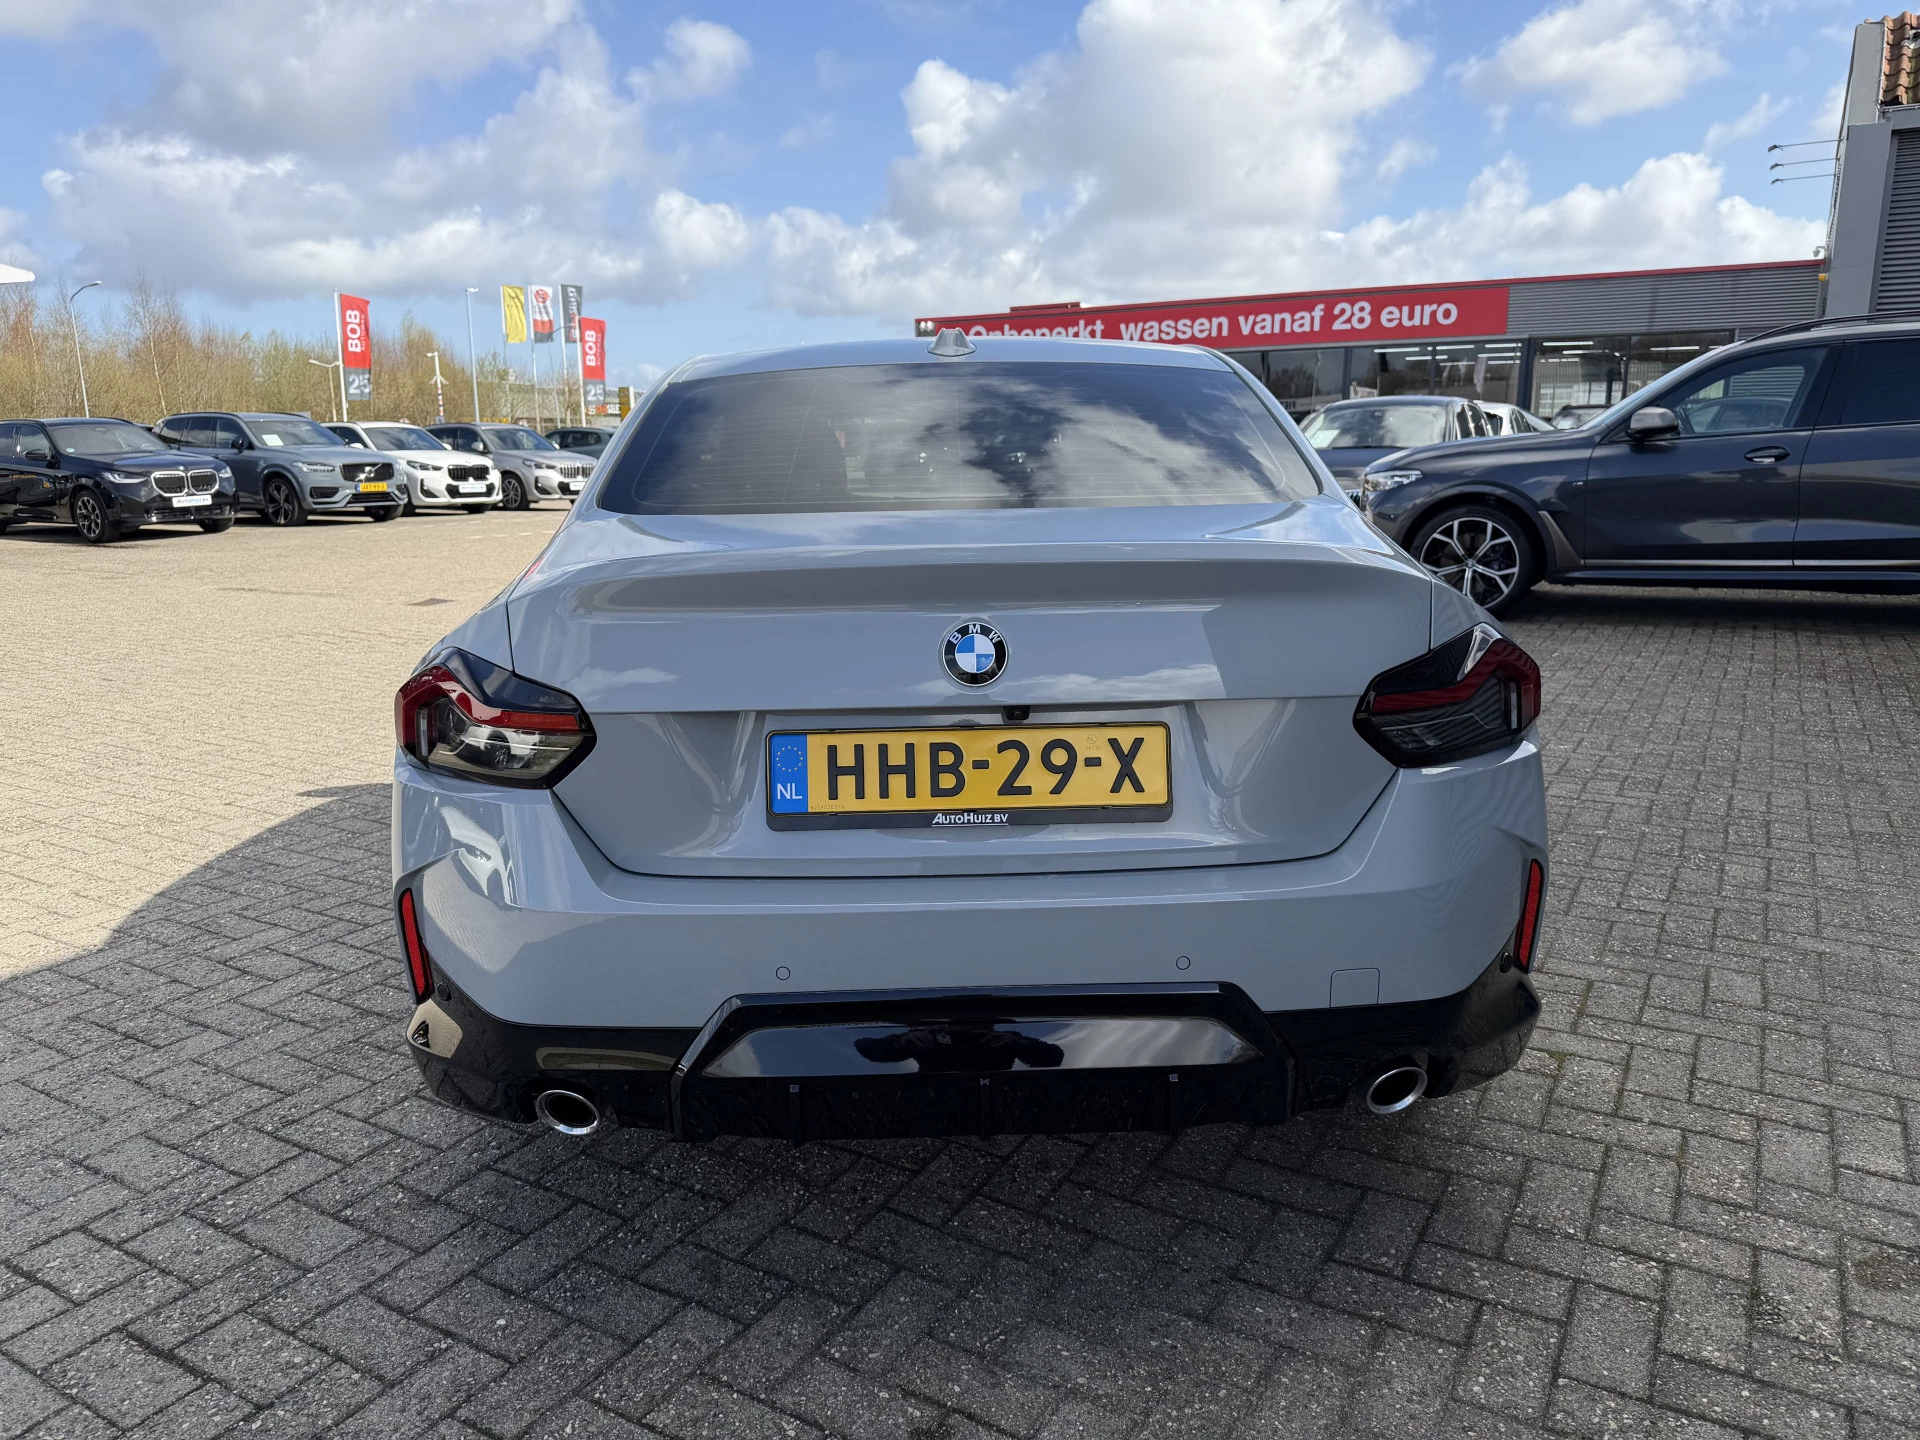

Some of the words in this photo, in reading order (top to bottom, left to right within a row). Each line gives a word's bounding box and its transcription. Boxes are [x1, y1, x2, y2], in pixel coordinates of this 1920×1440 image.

[345, 309, 361, 353] BOB
[1120, 316, 1229, 342] wassen
[1238, 304, 1325, 336] vanaf
[1332, 301, 1372, 331] 28
[1380, 303, 1458, 328] euro
[585, 330, 597, 367] BOB
[349, 374, 371, 394] 25
[586, 384, 604, 401] 25
[948, 624, 1002, 645] BMW
[826, 737, 1145, 800] HHB-29-X
[776, 783, 803, 801] NL
[994, 813, 1009, 823] BV
